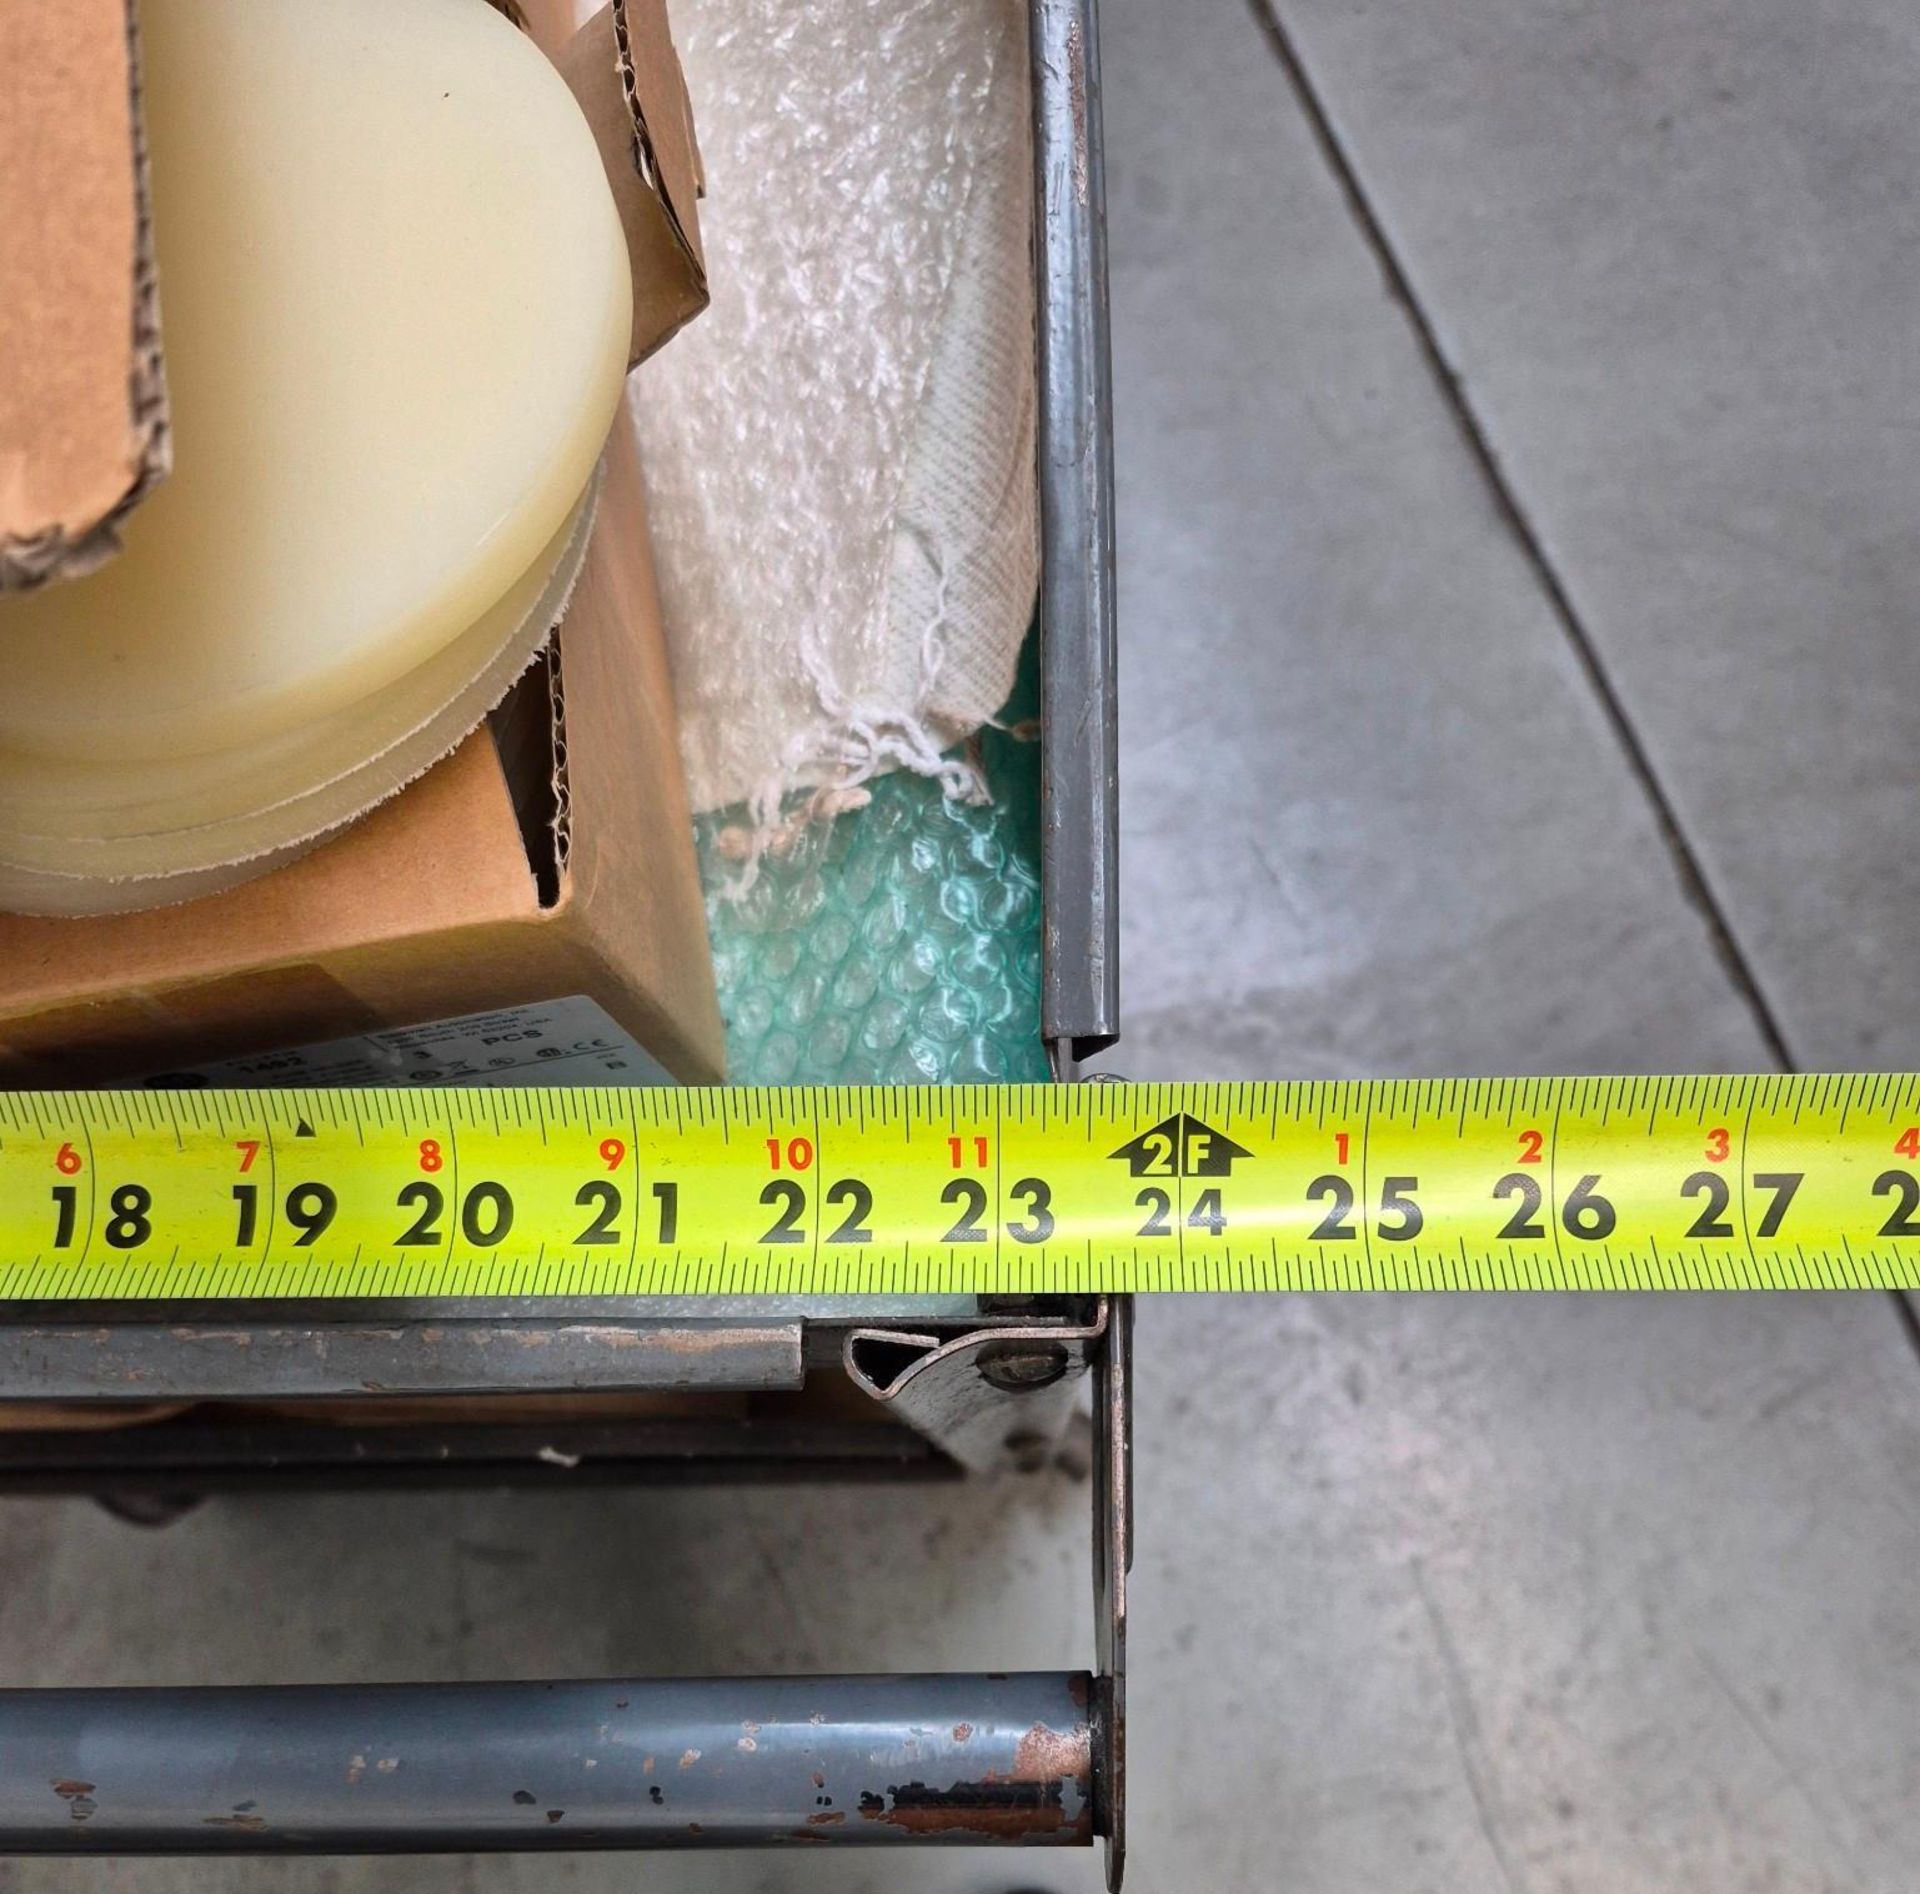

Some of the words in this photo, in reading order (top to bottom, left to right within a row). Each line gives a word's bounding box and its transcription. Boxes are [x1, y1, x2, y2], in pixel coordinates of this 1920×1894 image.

[482, 1029, 543, 1046] PCS
[55, 1143, 81, 1176] 6
[235, 1141, 258, 1172] 7
[419, 1139, 443, 1173] 8
[598, 1139, 625, 1171] 9
[767, 1138, 813, 1171] 10
[948, 1136, 988, 1169] 11
[1142, 1133, 1209, 1175] 2F
[1335, 1132, 1349, 1165] 1
[1519, 1130, 1543, 1164] 2
[1706, 1127, 1730, 1163] 3
[1893, 1127, 1920, 1159] 4
[52, 1184, 151, 1249] 18
[233, 1182, 337, 1247] 19
[394, 1182, 513, 1246] 20
[573, 1181, 677, 1244] 21
[758, 1178, 873, 1243] 22
[940, 1177, 1054, 1243] 23
[1134, 1188, 1228, 1236] 24
[1307, 1175, 1423, 1241] 25
[1493, 1173, 1616, 1241] 26
[1680, 1171, 1805, 1238] 27
